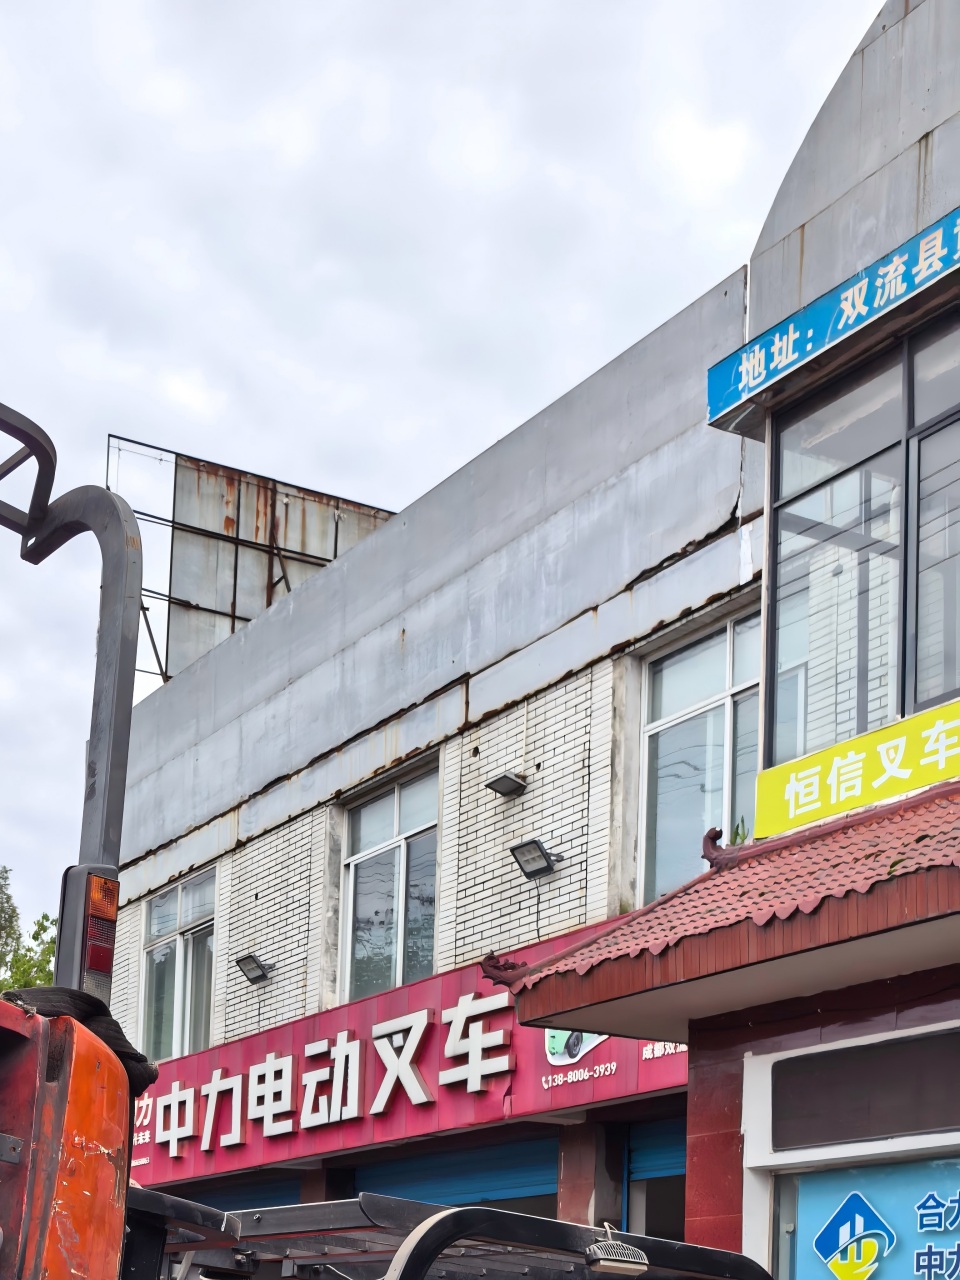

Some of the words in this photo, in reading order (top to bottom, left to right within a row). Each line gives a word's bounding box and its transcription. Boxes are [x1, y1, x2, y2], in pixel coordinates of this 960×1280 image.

[737, 217, 960, 392] 地址：双流县
[784, 719, 960, 819] 恒信叉车
[155, 991, 515, 1158] 中力电动叉车
[547, 1061, 617, 1088] 138-8006-3939
